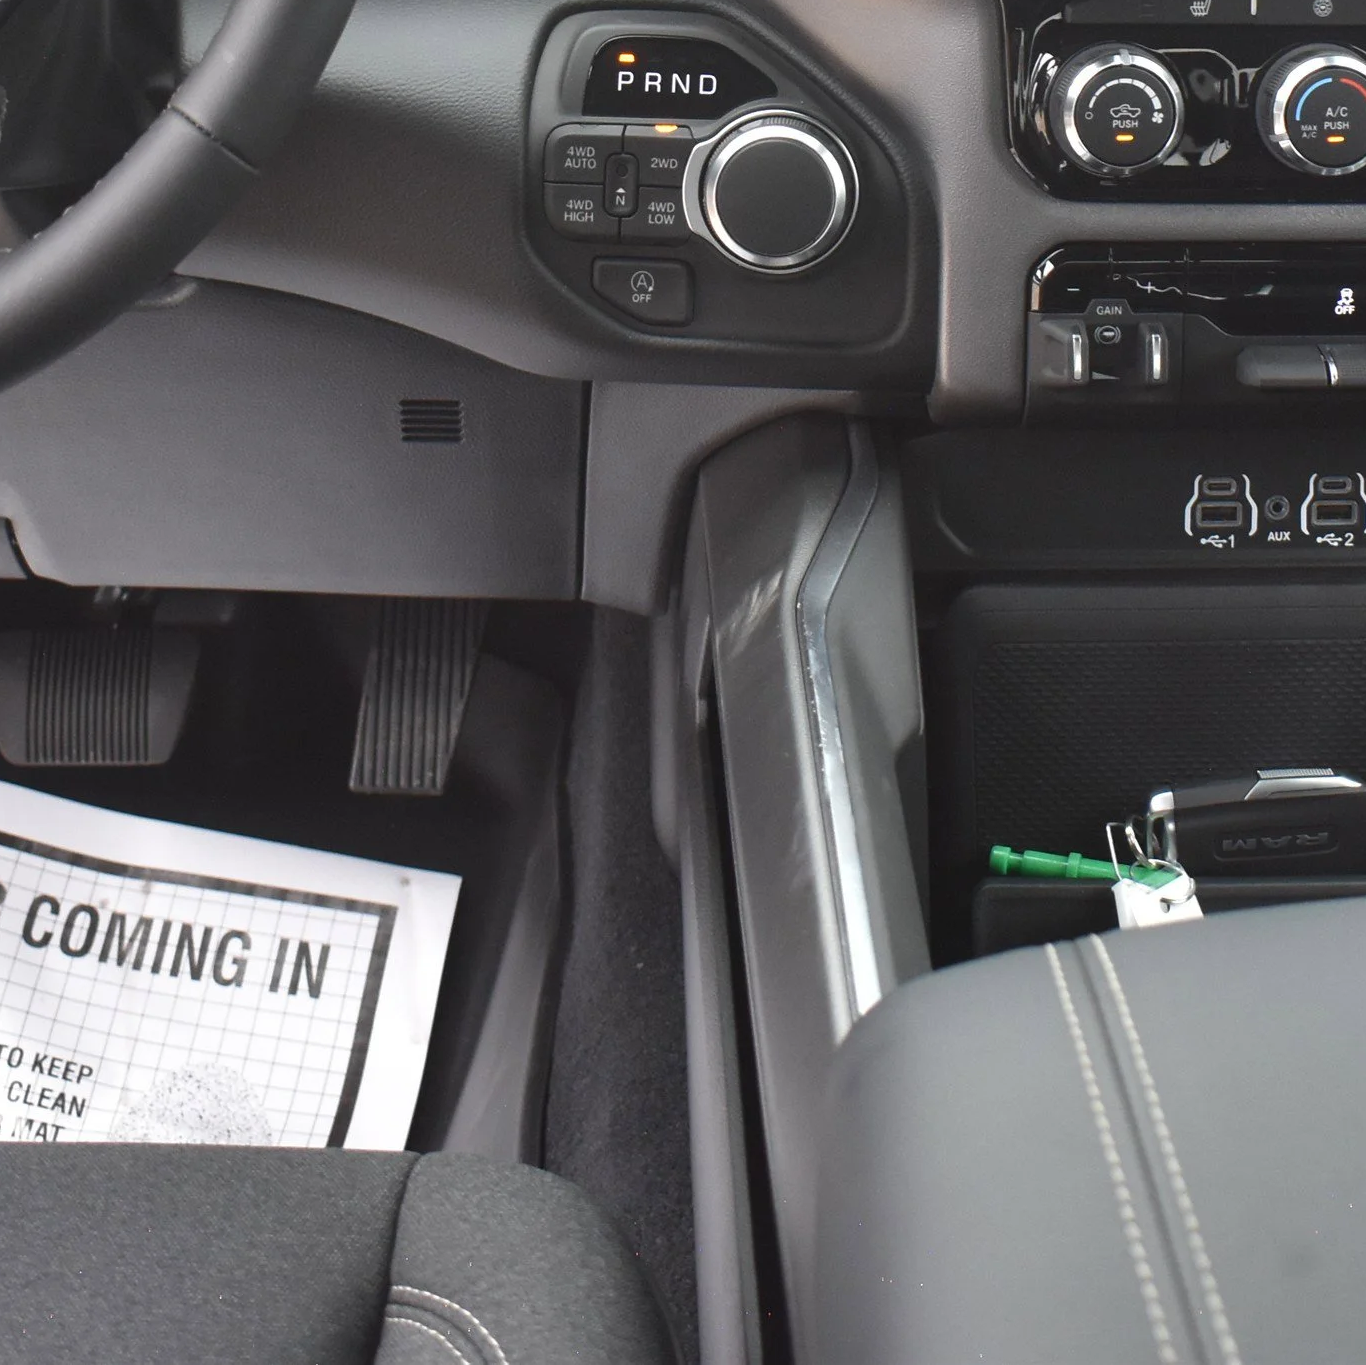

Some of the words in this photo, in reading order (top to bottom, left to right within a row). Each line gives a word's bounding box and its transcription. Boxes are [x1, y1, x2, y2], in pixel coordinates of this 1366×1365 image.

[1325, 106, 1349, 118] A/C
[1112, 119, 1139, 129] PUSH
[1300, 124, 1317, 132] MAX
[1323, 120, 1350, 131] PUSH
[1301, 131, 1317, 139] A/C
[567, 146, 596, 158] 4WD
[564, 157, 597, 170] AUTO
[650, 157, 678, 169] 2WD
[566, 199, 594, 211] 4WD
[616, 195, 626, 206] N
[647, 202, 676, 214] 4WD
[564, 210, 594, 223] HIGH
[648, 213, 676, 225] LOW
[632, 293, 652, 304] OFF
[1096, 305, 1123, 315] GAIN
[1335, 305, 1355, 315] OFF
[1267, 531, 1291, 542] AUX
[1344, 533, 1354, 547] 2
[1222, 831, 1329, 852] RAM
[22, 894, 253, 989] COMING
[269, 936, 332, 1000] IN
[31, 1052, 94, 1084] KEEP
[7, 1080, 87, 1118] CLEAN
